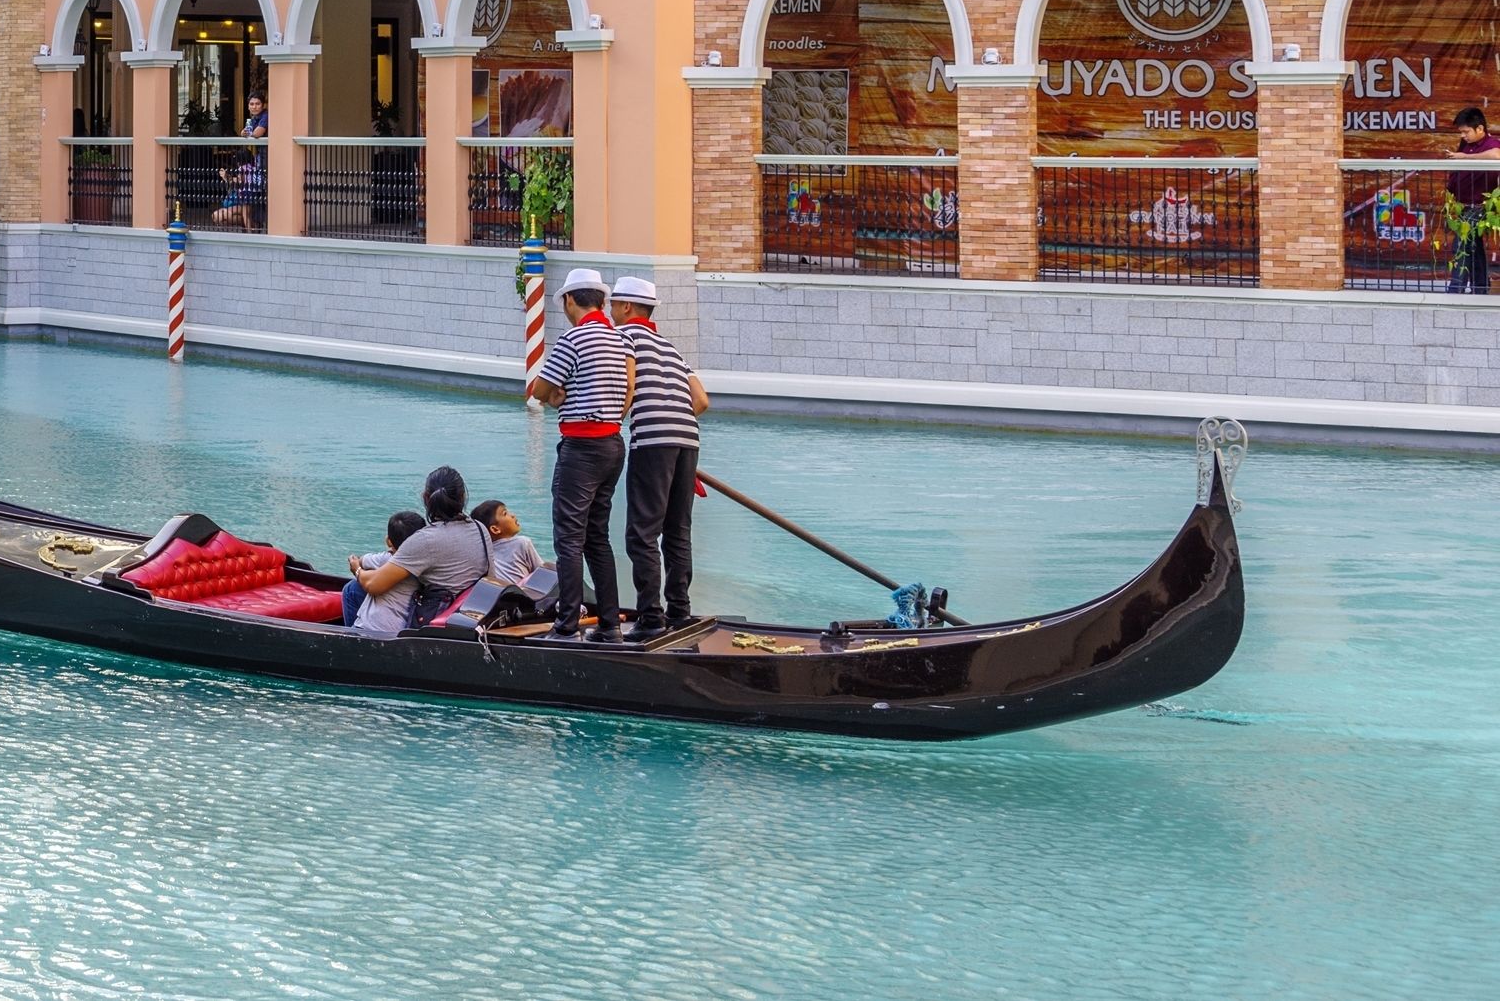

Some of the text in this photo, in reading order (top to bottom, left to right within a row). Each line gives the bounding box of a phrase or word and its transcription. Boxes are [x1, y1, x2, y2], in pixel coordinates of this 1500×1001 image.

[532, 39, 566, 52] A ne
[769, 36, 827, 50] noodles.
[1143, 110, 1181, 129] THE
[1189, 110, 1259, 129] HOUS
